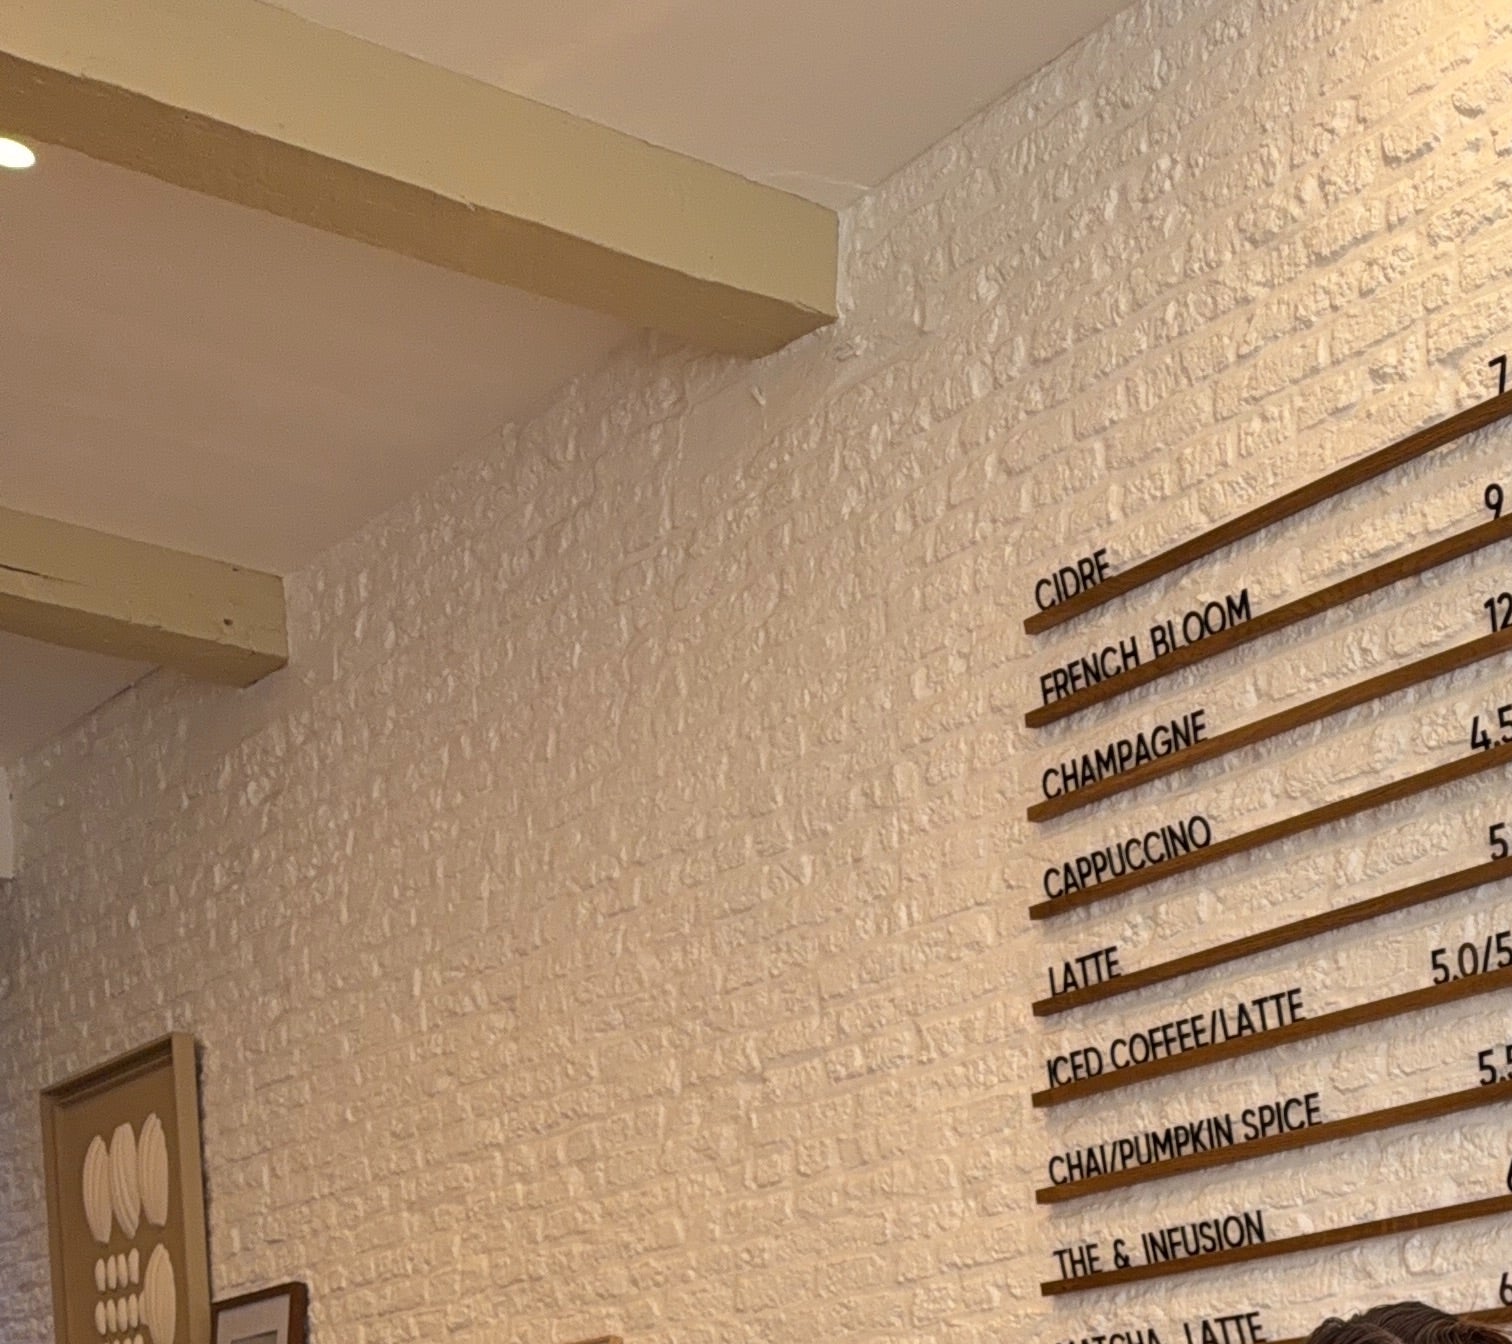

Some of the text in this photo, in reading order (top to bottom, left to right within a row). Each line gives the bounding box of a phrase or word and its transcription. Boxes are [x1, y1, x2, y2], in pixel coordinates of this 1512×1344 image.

[1034, 354, 1507, 612] CIDRE 7
[1039, 483, 1504, 706] FRENCH BLOOM 9
[1041, 708, 1208, 800] CHAMPAGNE
[1043, 815, 1212, 899] CAPPUCCINO
[1048, 823, 1509, 998] LATTE 5
[1046, 1046, 1103, 1088] ICED
[1109, 987, 1307, 1069] COFFEE/LATTE
[1048, 1113, 1234, 1186] CHAI/PUMPKIN
[1241, 1092, 1323, 1141] SPICE
[1053, 1243, 1102, 1280] THE
[1112, 1238, 1131, 1269] &
[1141, 1209, 1266, 1264] INFUSION
